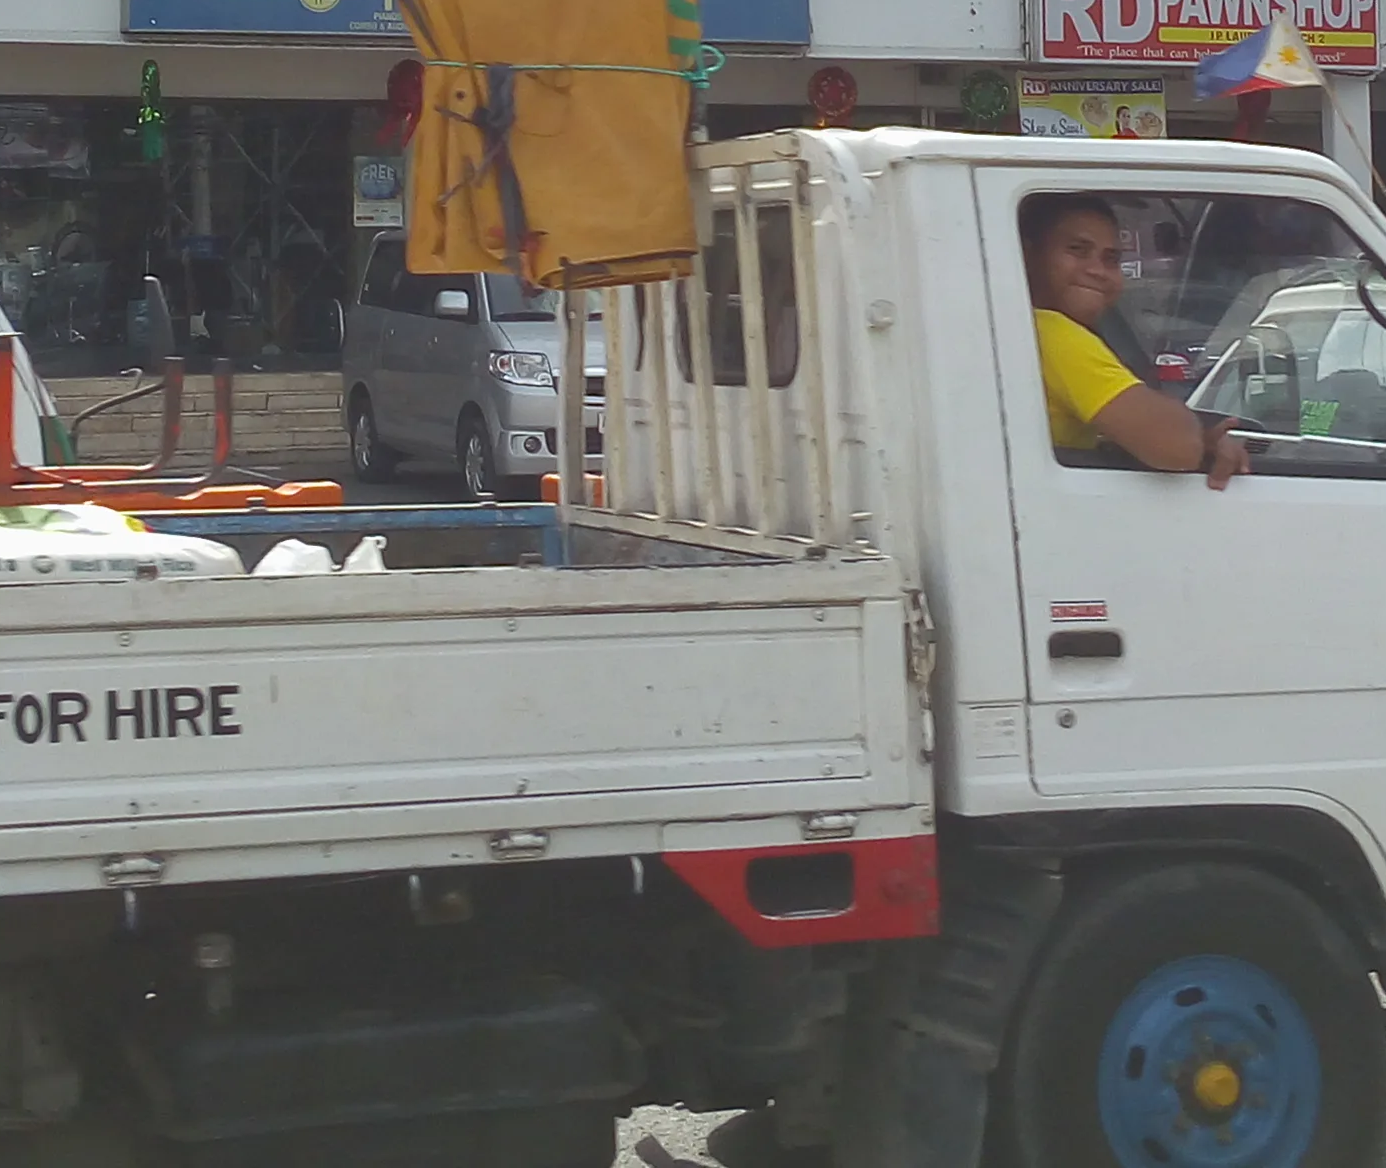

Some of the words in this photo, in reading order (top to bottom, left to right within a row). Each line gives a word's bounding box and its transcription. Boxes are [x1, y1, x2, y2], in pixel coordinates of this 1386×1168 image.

[1109, 46, 1138, 60] place
[1143, 47, 1165, 58] that
[1169, 50, 1189, 59] can
[1023, 79, 1046, 94] RD
[1050, 81, 1128, 92] ANNIVERSARY
[1131, 81, 1162, 92] SALE!
[362, 163, 396, 182] FREE
[106, 685, 243, 740] HIRE
